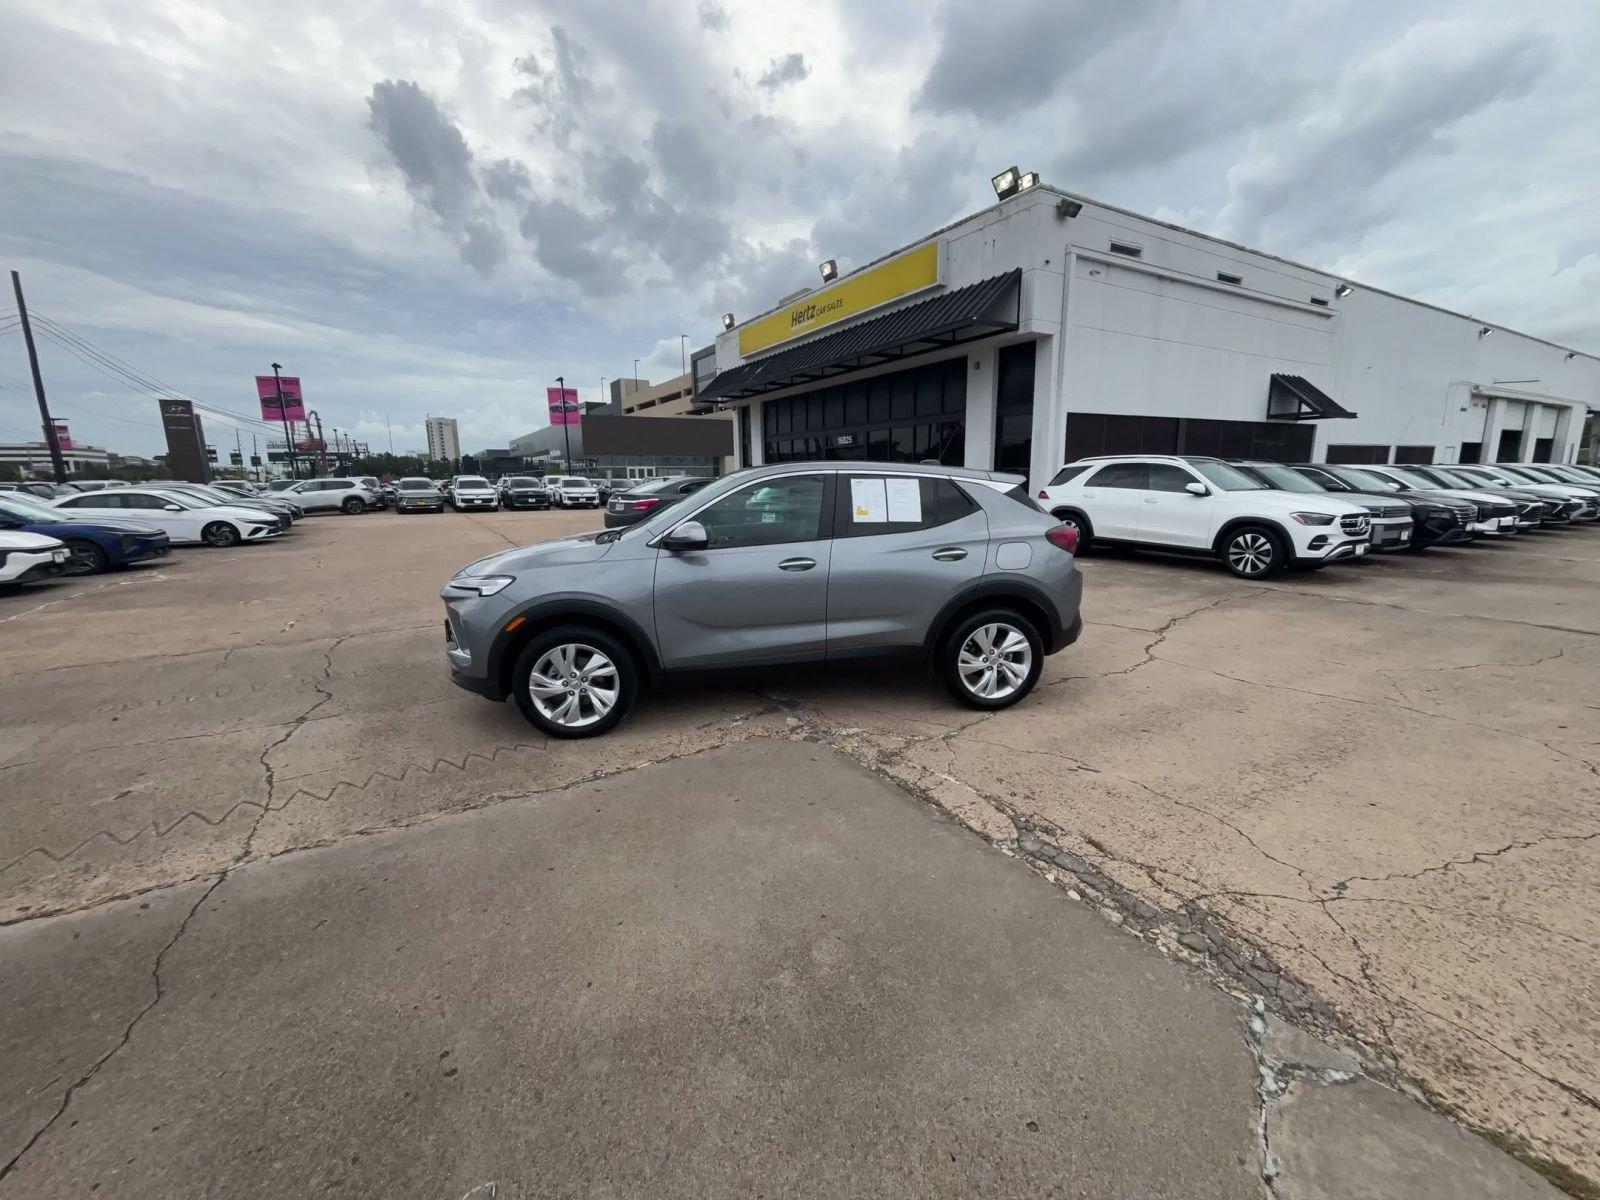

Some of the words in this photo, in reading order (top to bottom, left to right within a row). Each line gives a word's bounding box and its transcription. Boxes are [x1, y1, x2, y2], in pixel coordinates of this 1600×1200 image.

[791, 304, 816, 327] Hertz
[815, 306, 826, 317] CAR
[826, 298, 843, 312] SALES
